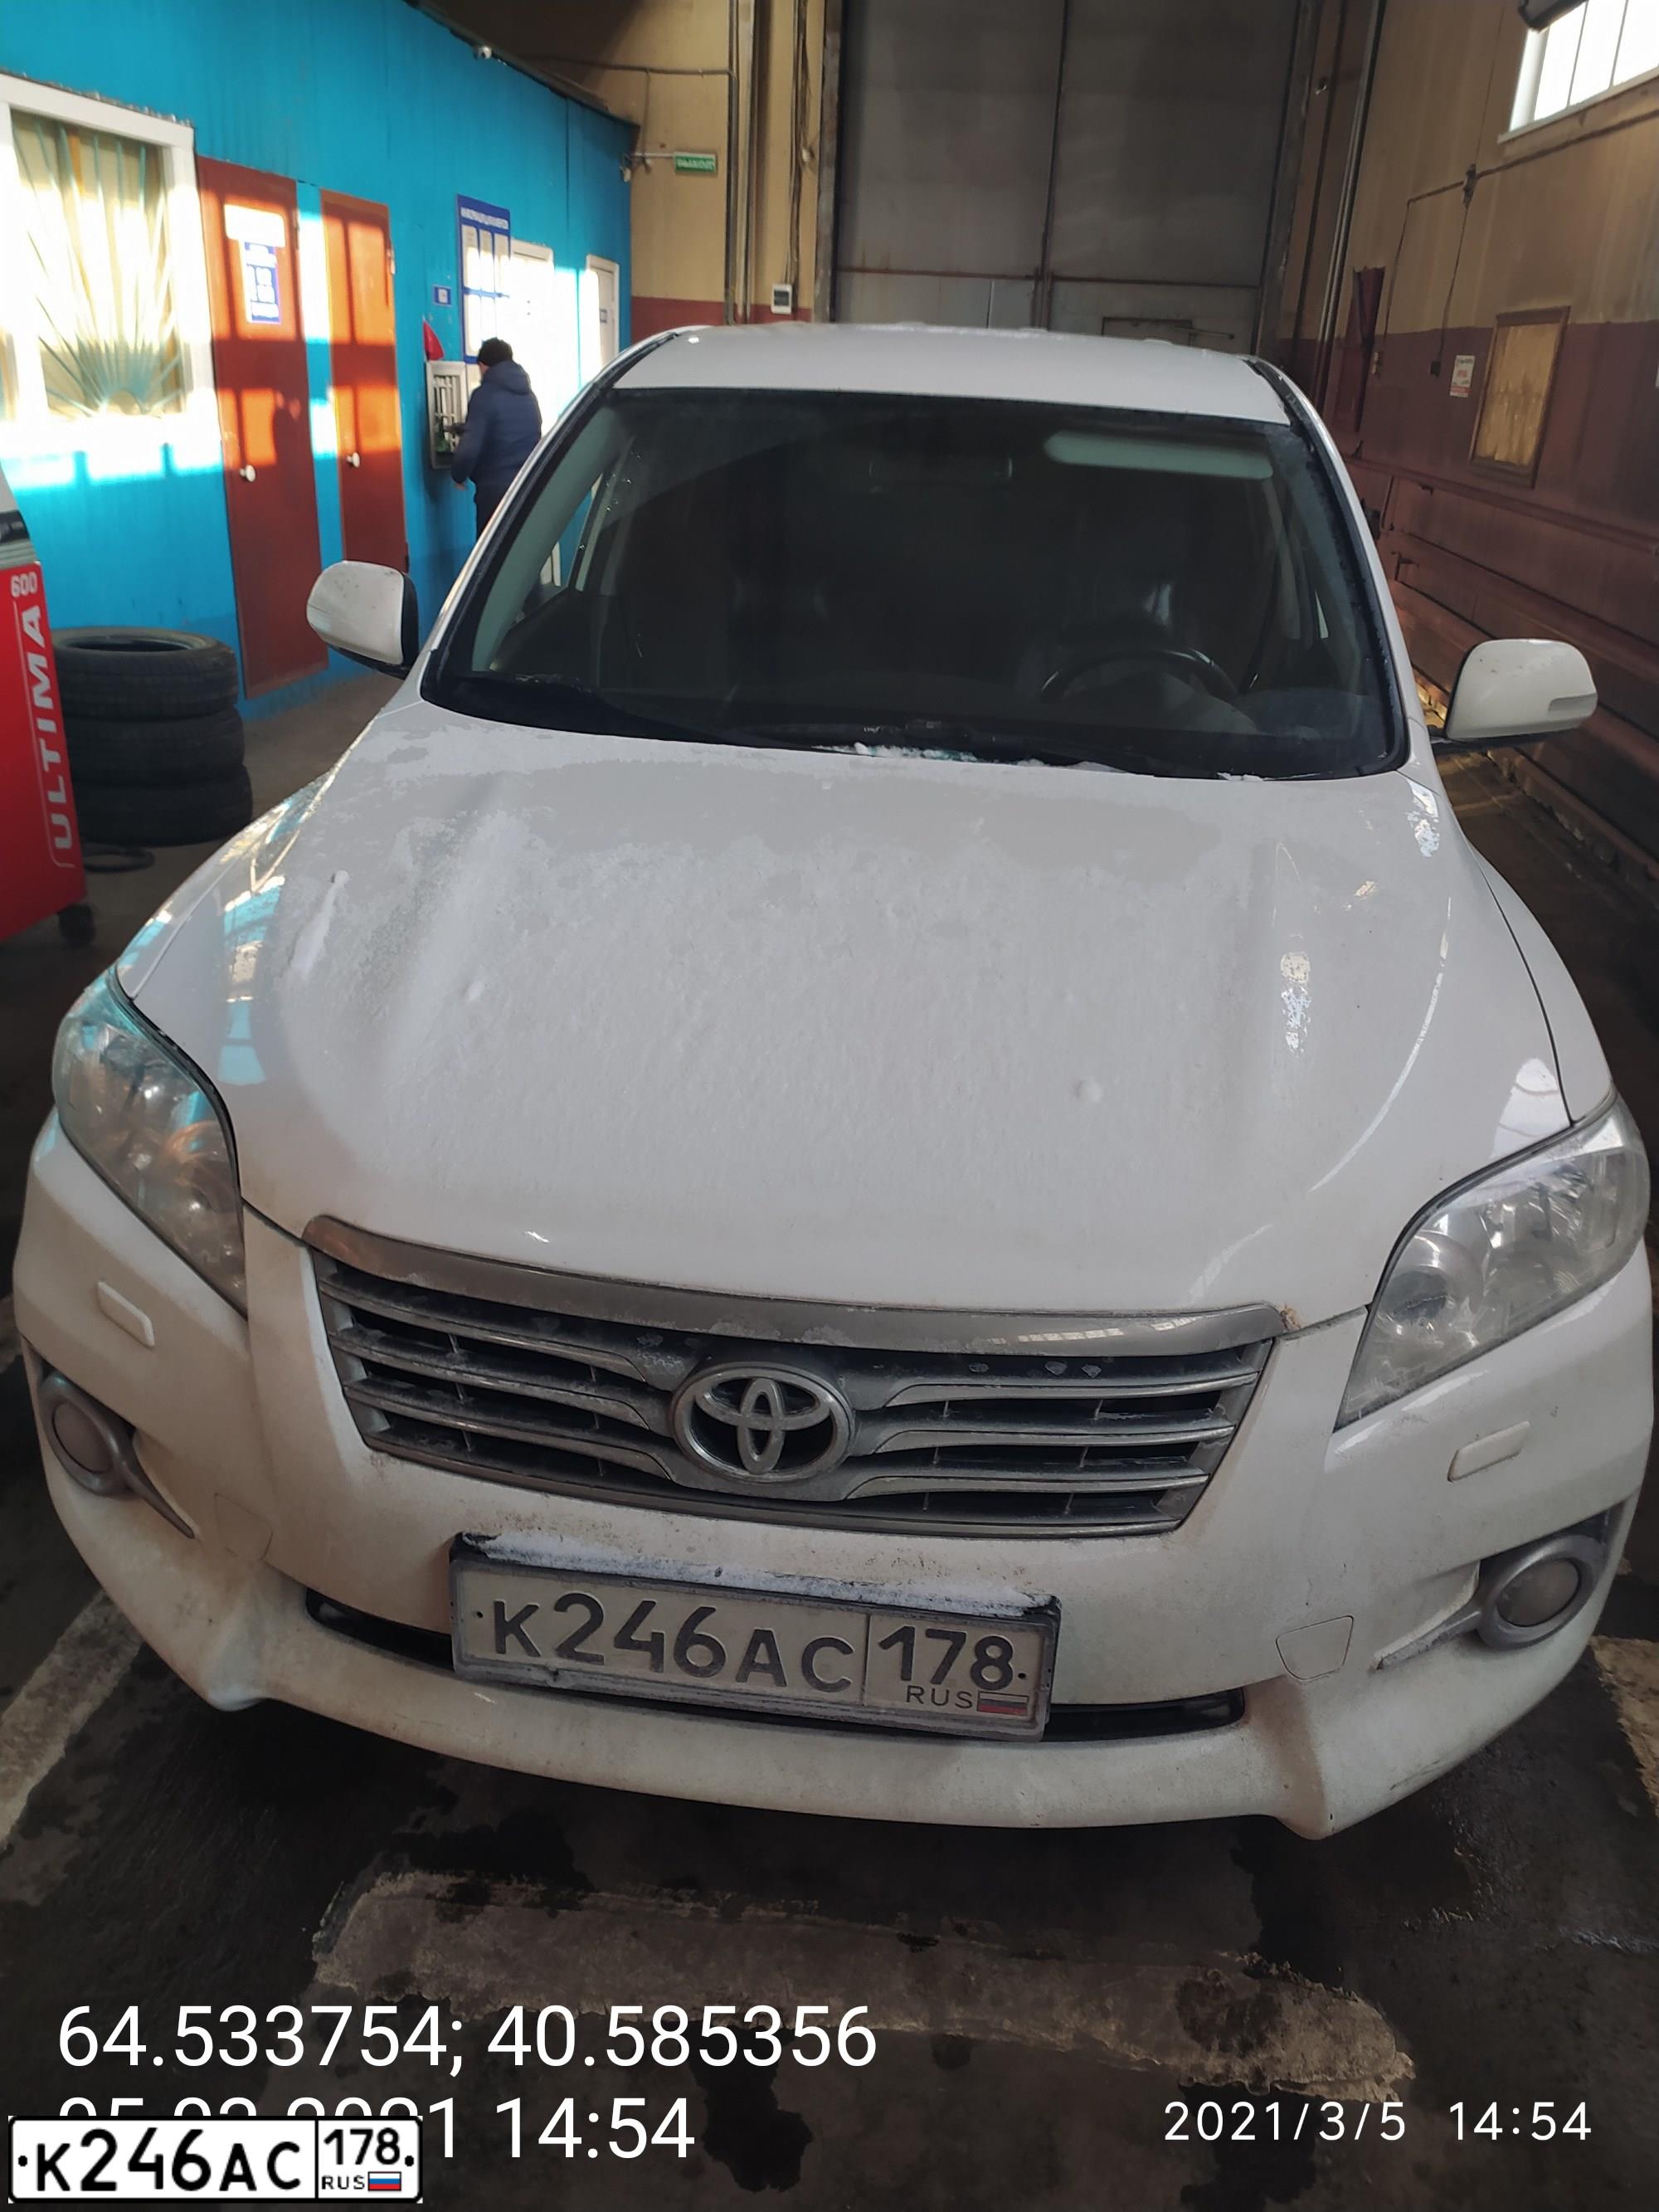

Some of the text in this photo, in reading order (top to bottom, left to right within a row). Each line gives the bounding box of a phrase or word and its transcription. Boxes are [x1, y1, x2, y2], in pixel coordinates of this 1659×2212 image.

[11, 571, 38, 598] 600
[22, 604, 73, 851] ULTIMA
[878, 1625, 1016, 1692] 178
[906, 1683, 974, 1709] RUS
